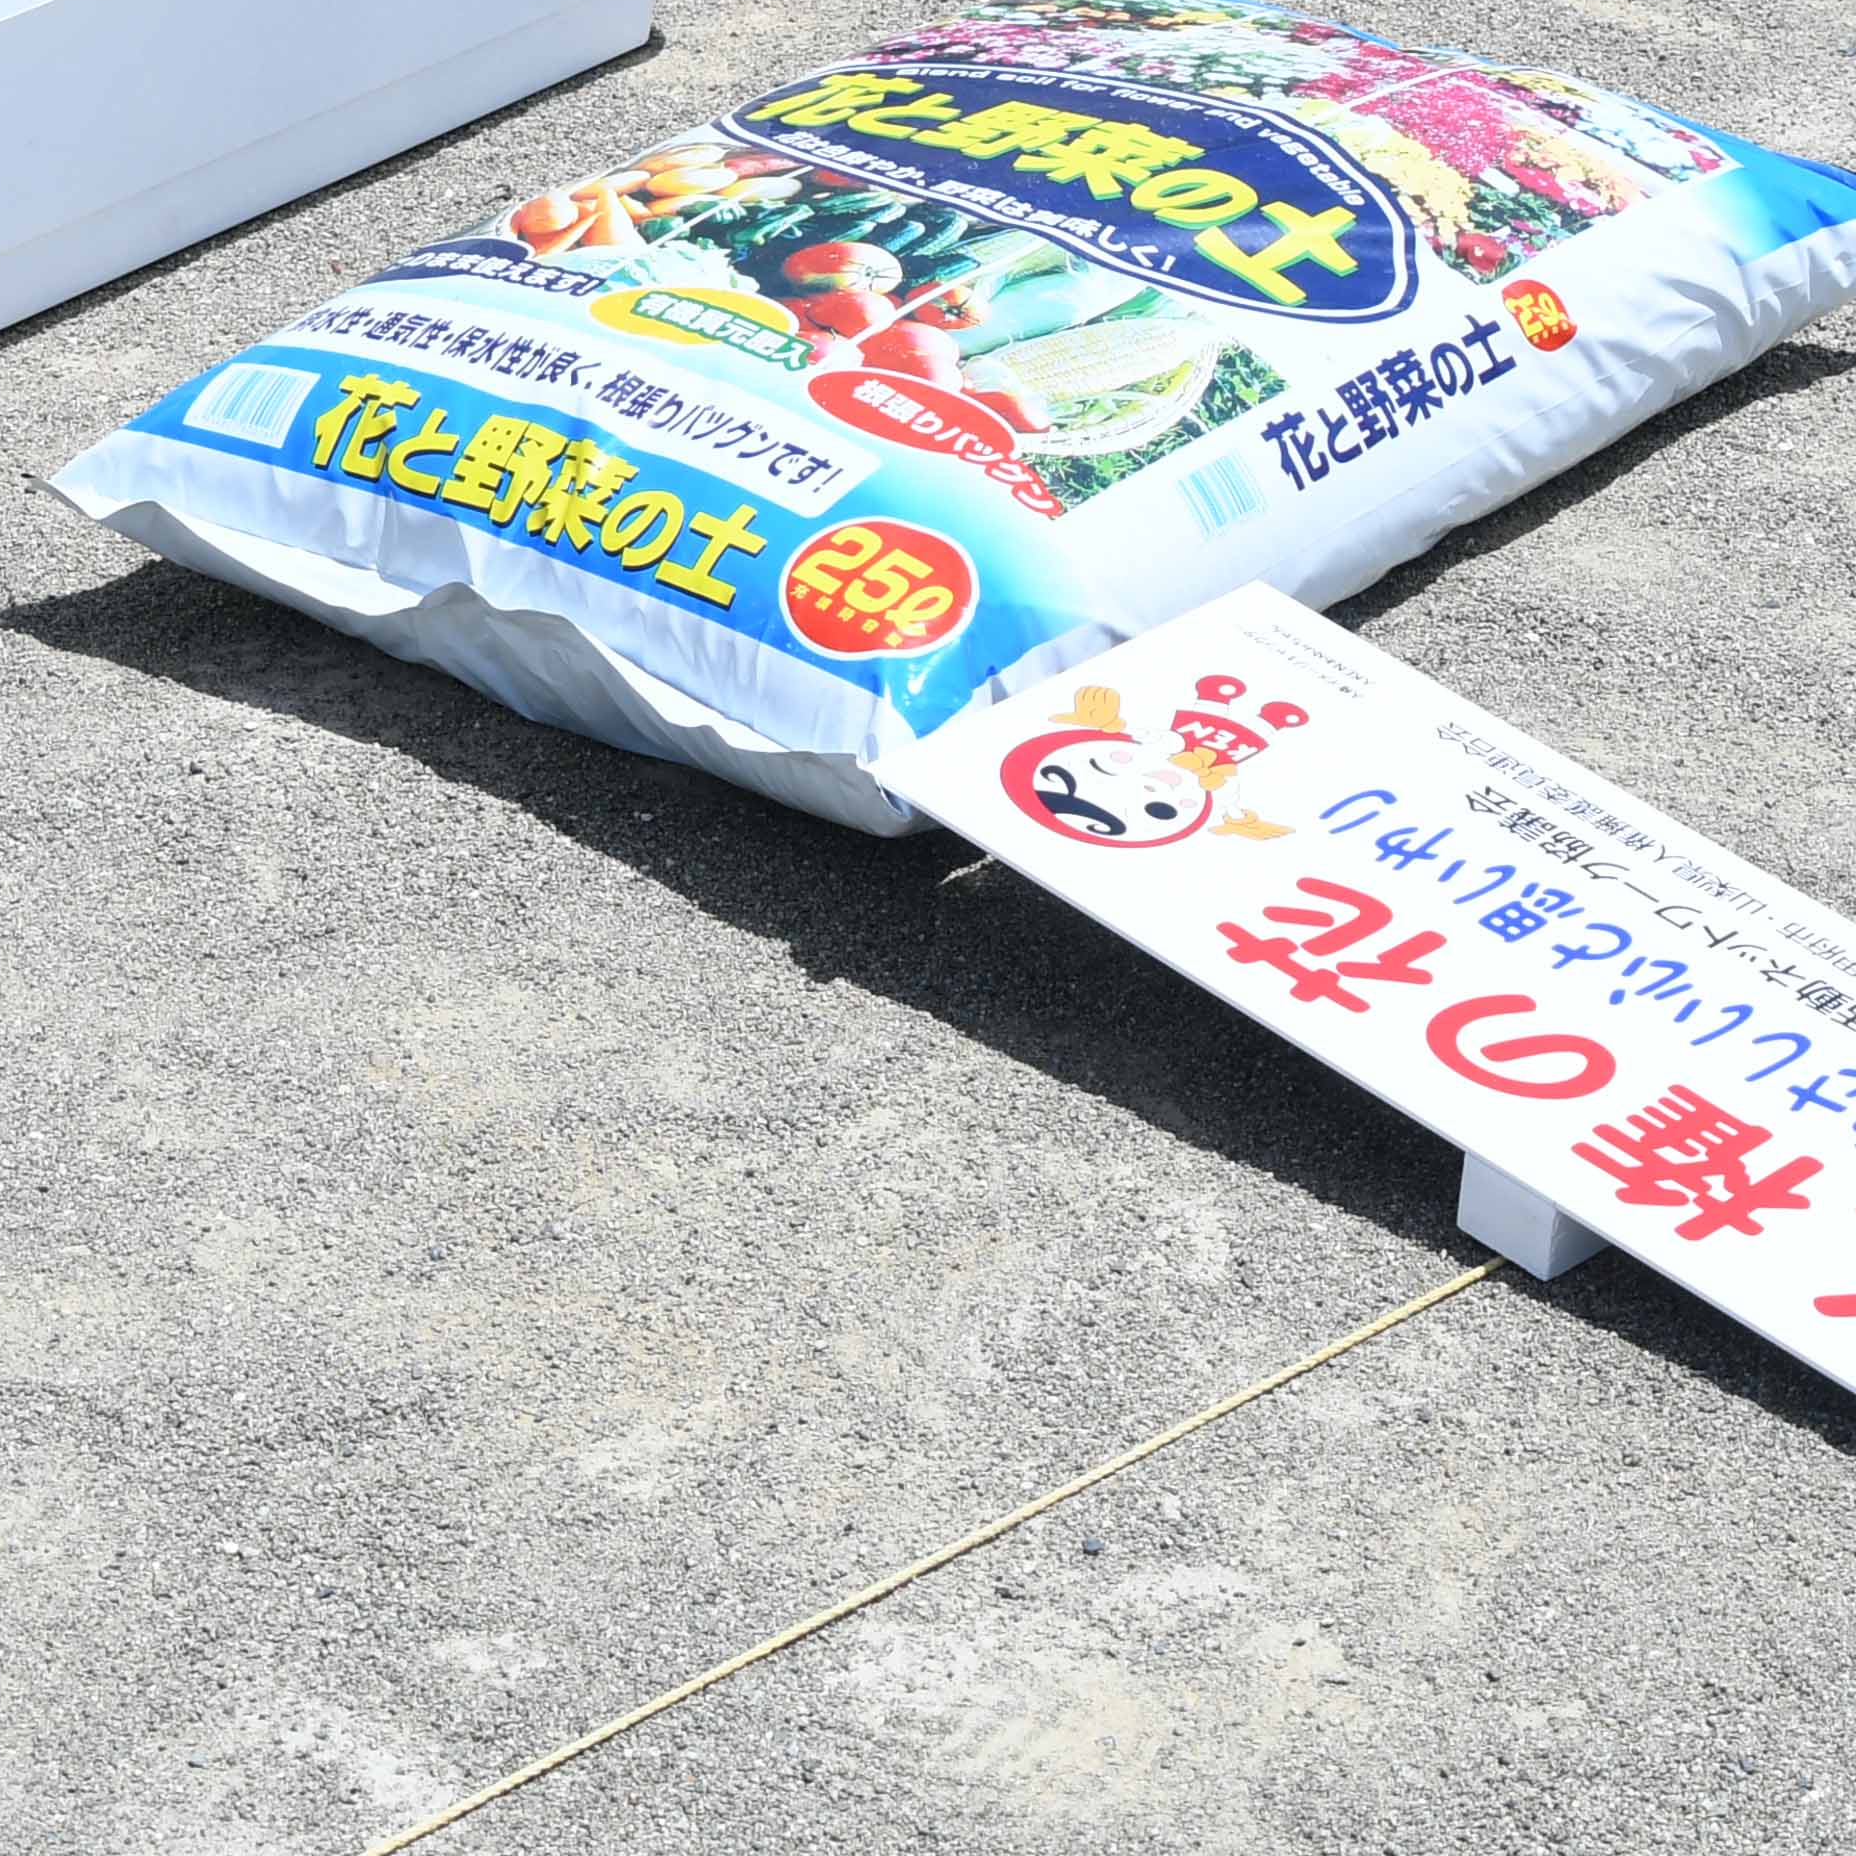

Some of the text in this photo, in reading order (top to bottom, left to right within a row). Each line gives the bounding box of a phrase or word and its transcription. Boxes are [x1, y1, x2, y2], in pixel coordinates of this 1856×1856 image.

[746, 72, 1360, 307] 花と野菜の土
[895, 67, 1365, 207] Blend soil for flower and vegetable
[390, 250, 601, 295] のまま使えます!
[852, 379, 1055, 509] 根張りバツグン
[1261, 313, 1517, 491] 花と野菜の土
[311, 373, 767, 608] 花と野菜の土
[1176, 721, 1258, 763] KEN
